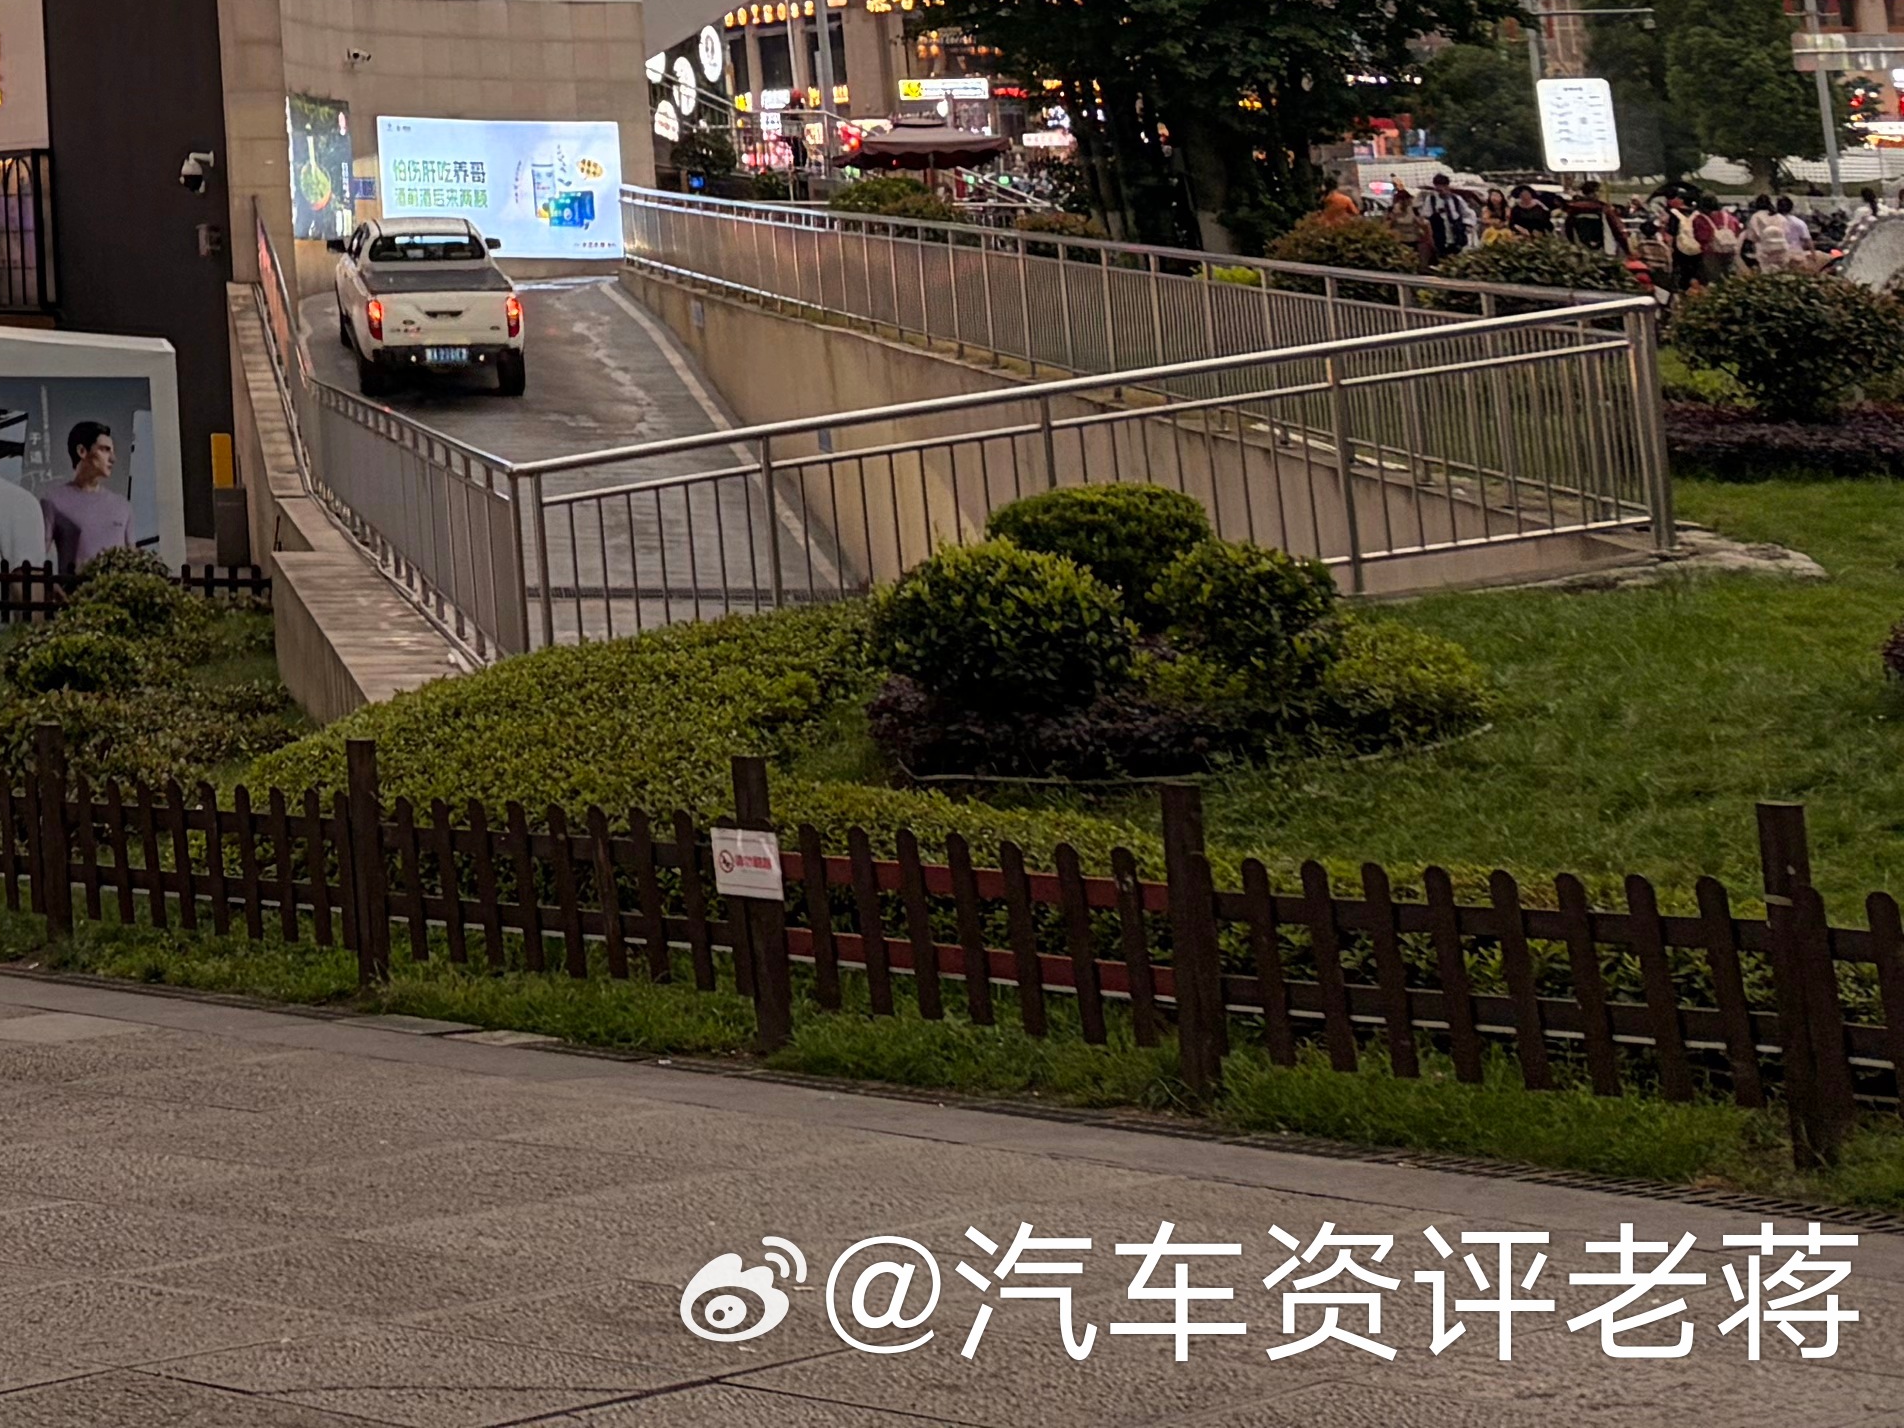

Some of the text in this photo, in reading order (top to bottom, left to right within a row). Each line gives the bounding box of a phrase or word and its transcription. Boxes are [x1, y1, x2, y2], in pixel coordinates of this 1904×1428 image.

[393, 159, 487, 184] 怕伤肝吃养哥
